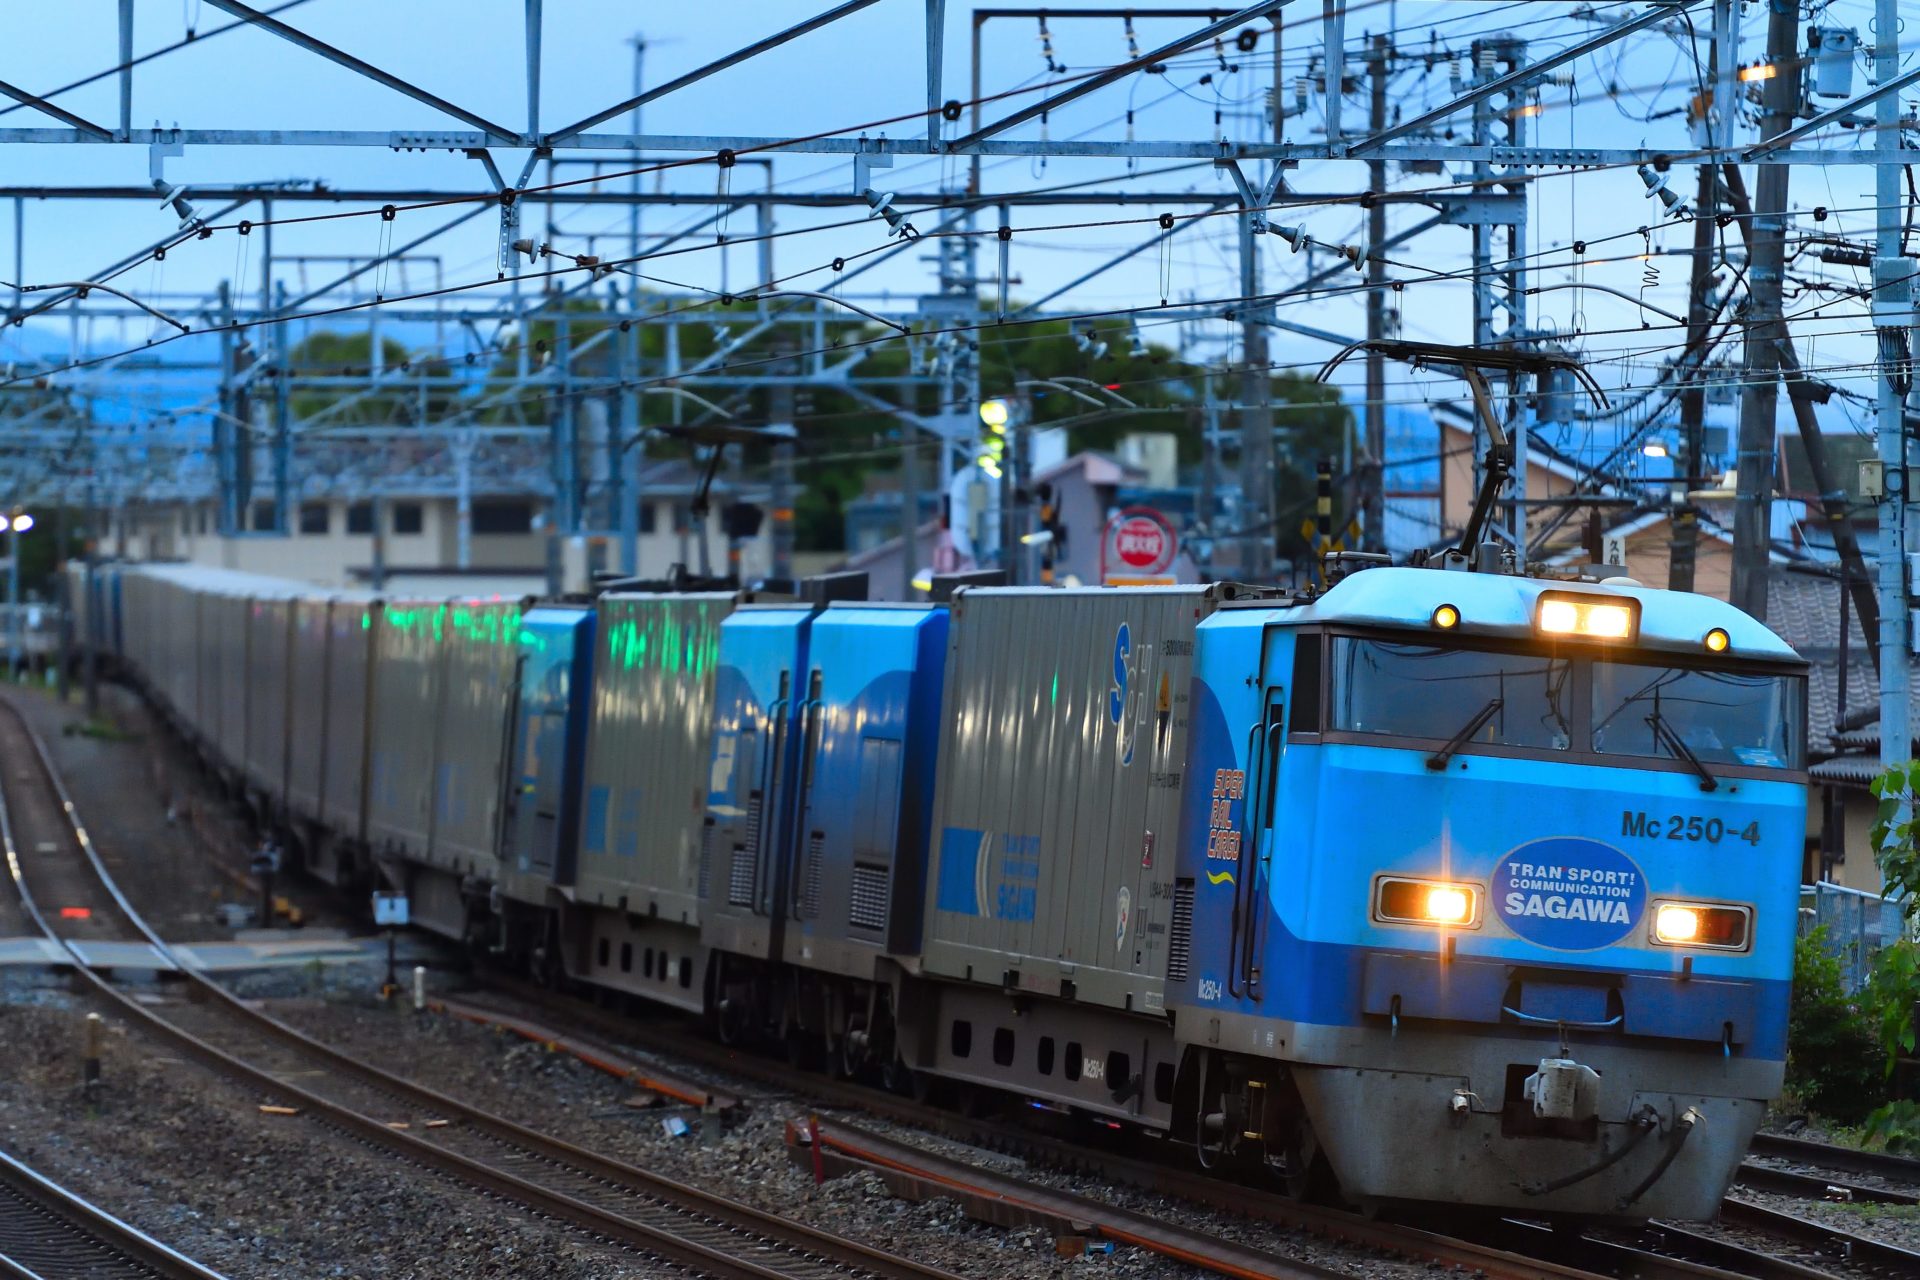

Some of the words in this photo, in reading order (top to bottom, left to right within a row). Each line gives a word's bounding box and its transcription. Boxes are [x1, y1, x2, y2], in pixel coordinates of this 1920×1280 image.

[1212, 768, 1245, 800] SUPER
[1209, 798, 1232, 829] RAIL
[1207, 828, 1242, 861] CARGO
[1510, 878, 1631, 898] COMMUNICATION
[1504, 892, 1631, 925] SAGAWA
